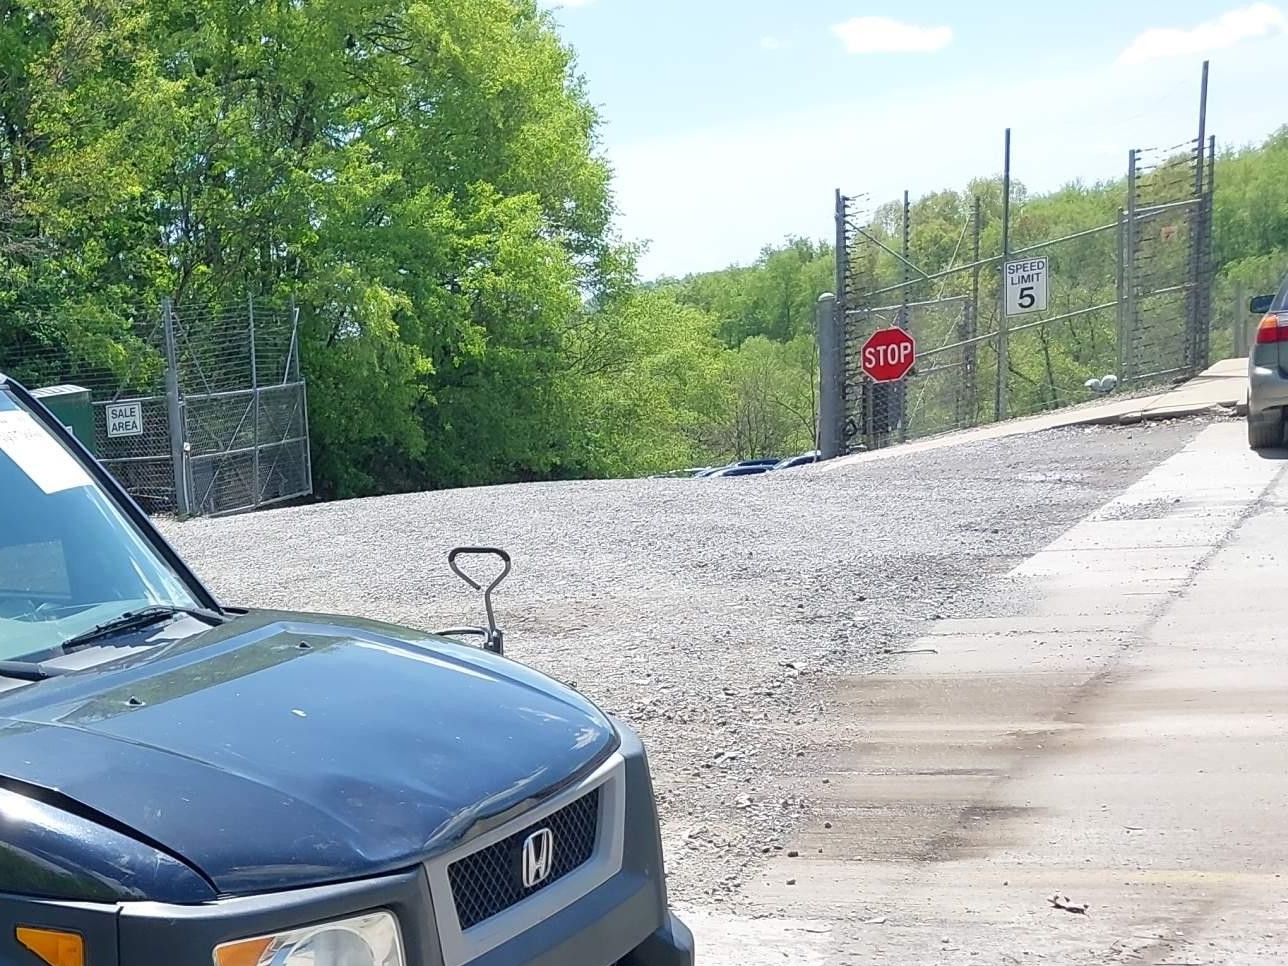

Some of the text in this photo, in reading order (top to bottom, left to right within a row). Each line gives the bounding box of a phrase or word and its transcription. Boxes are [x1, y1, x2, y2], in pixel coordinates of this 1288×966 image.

[1008, 261, 1045, 274] SPEED
[1011, 272, 1042, 285] LIMIT
[1017, 286, 1035, 308] 5
[865, 342, 911, 368] STOP
[111, 407, 136, 419] SALE
[112, 420, 138, 432] AREA
